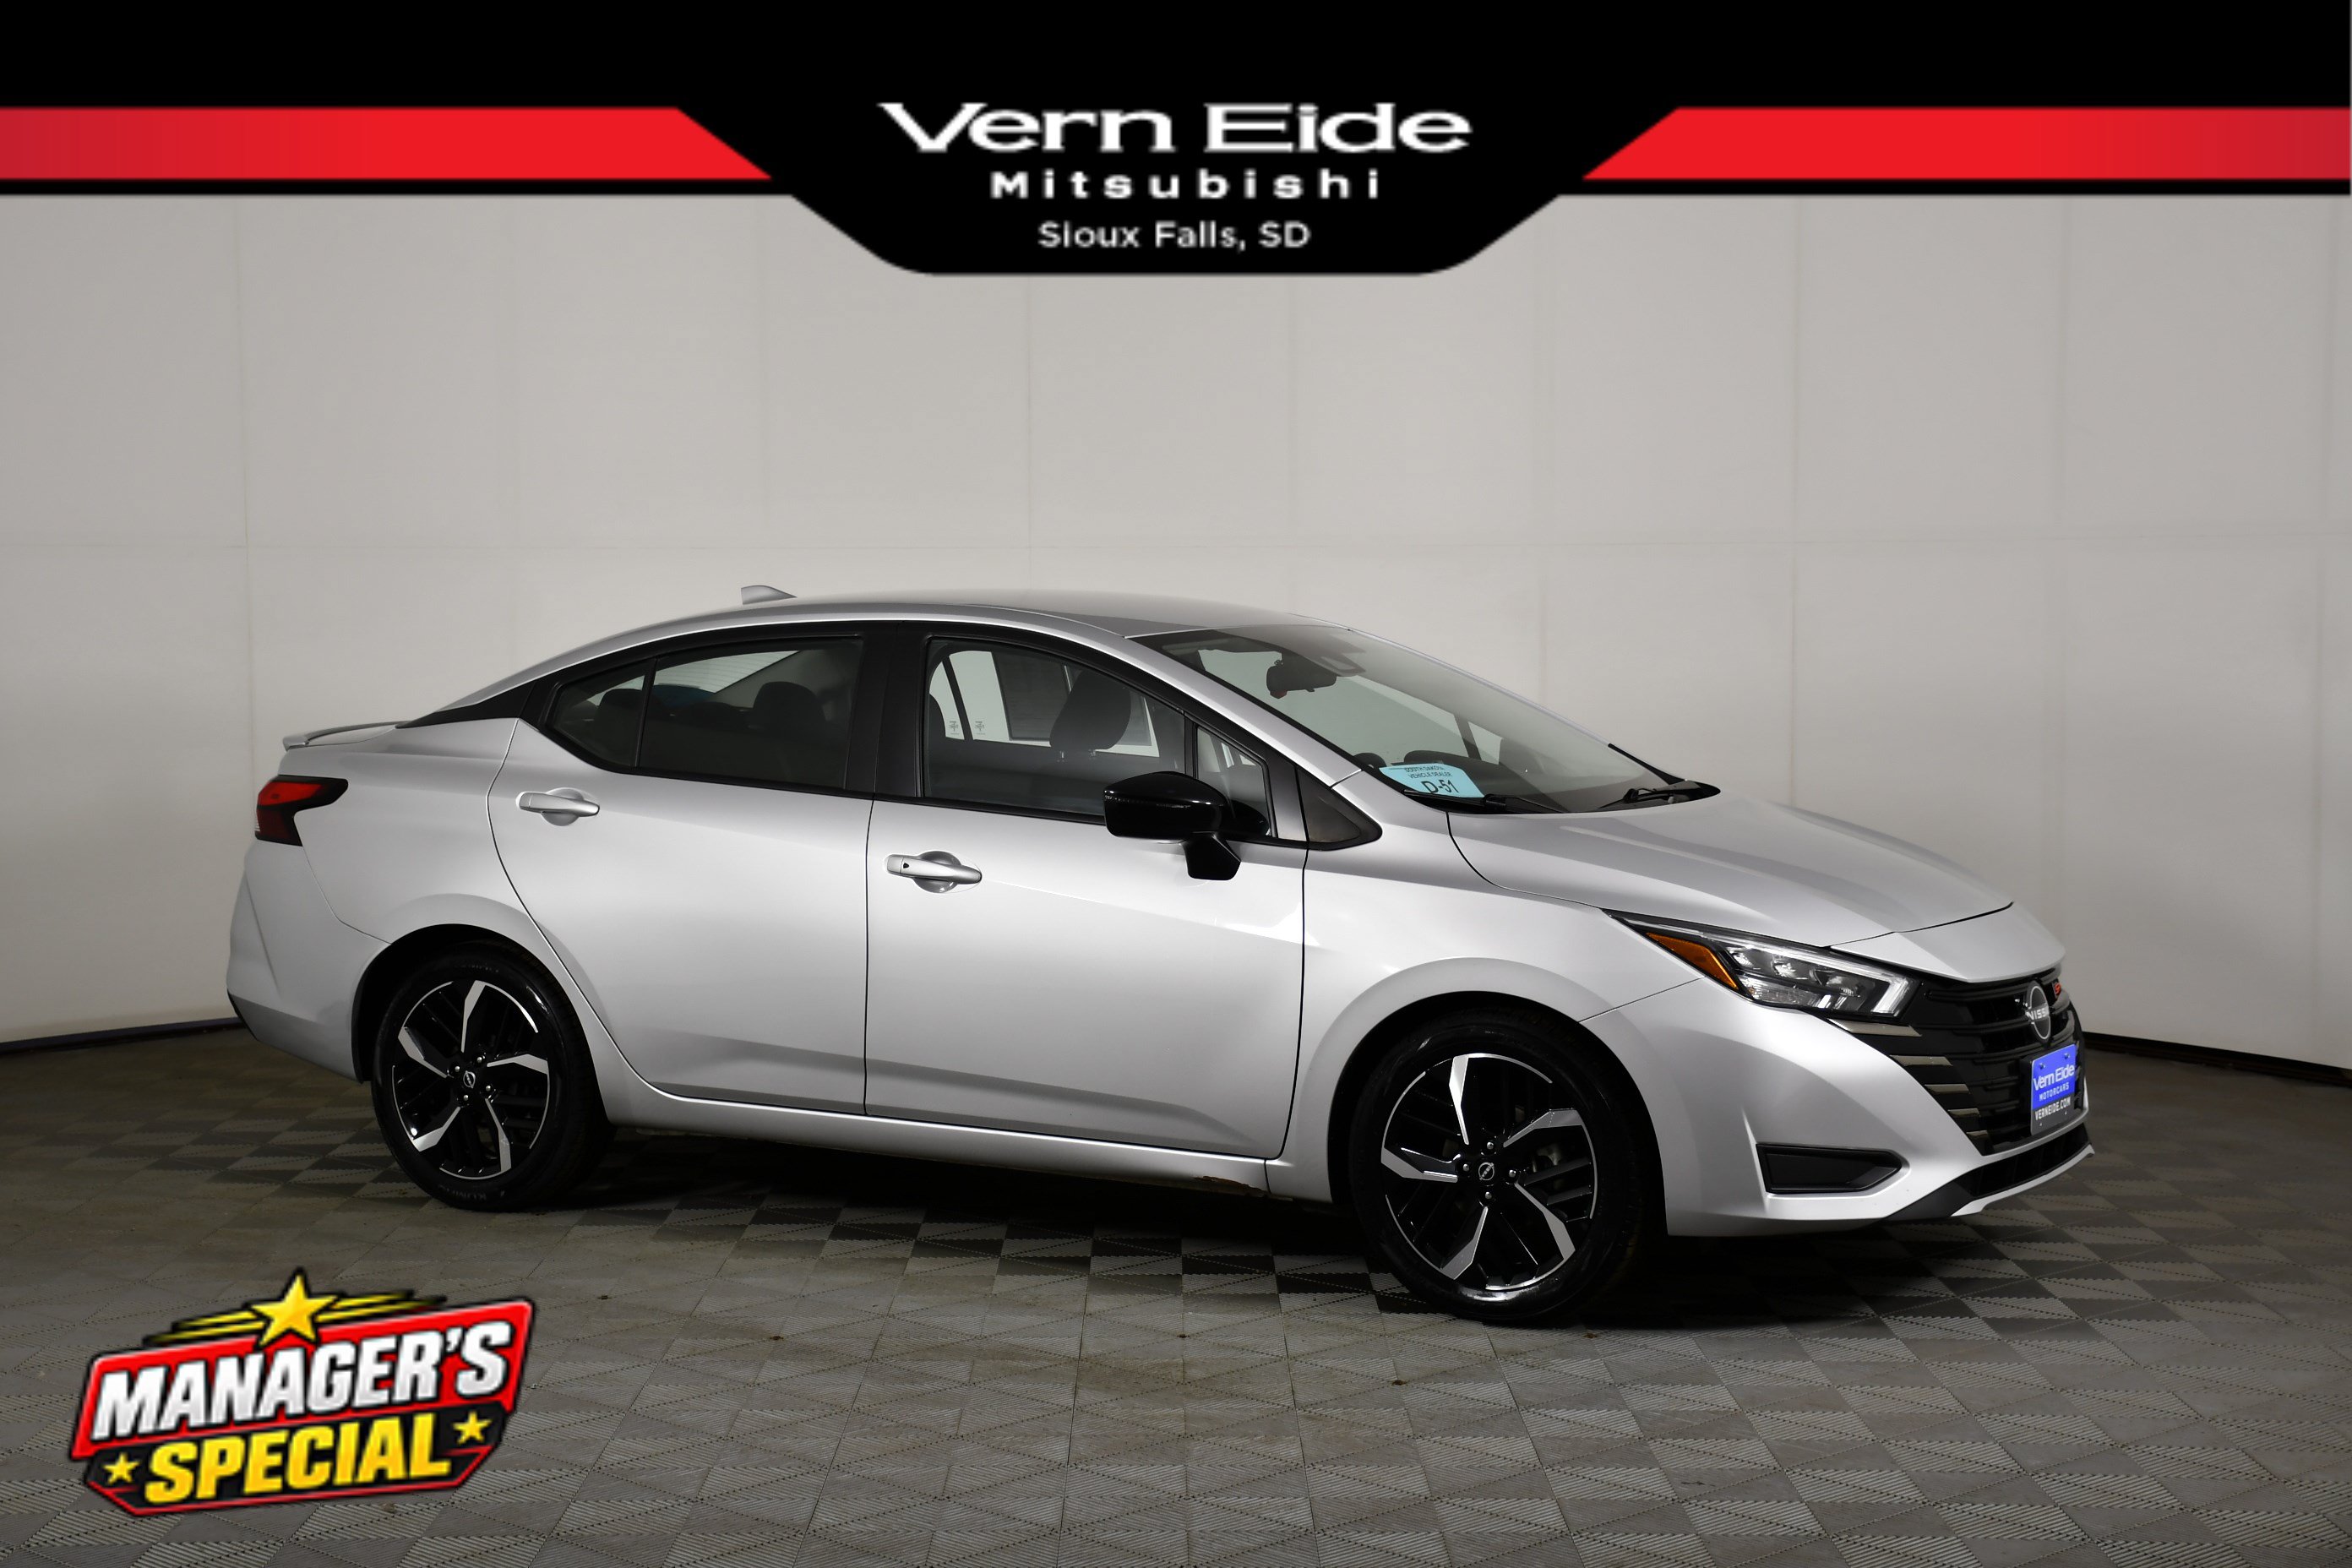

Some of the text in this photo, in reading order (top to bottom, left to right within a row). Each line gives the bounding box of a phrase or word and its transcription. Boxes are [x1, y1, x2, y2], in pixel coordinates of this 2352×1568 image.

[1421, 779, 1460, 793] D-51
[2025, 1005, 2049, 1020] NISS
[2033, 1064, 2075, 1091] Vern Eide
[2039, 1082, 2069, 1102] MOTORCARS
[2035, 1097, 2071, 1120] VERNEIDE.COM
